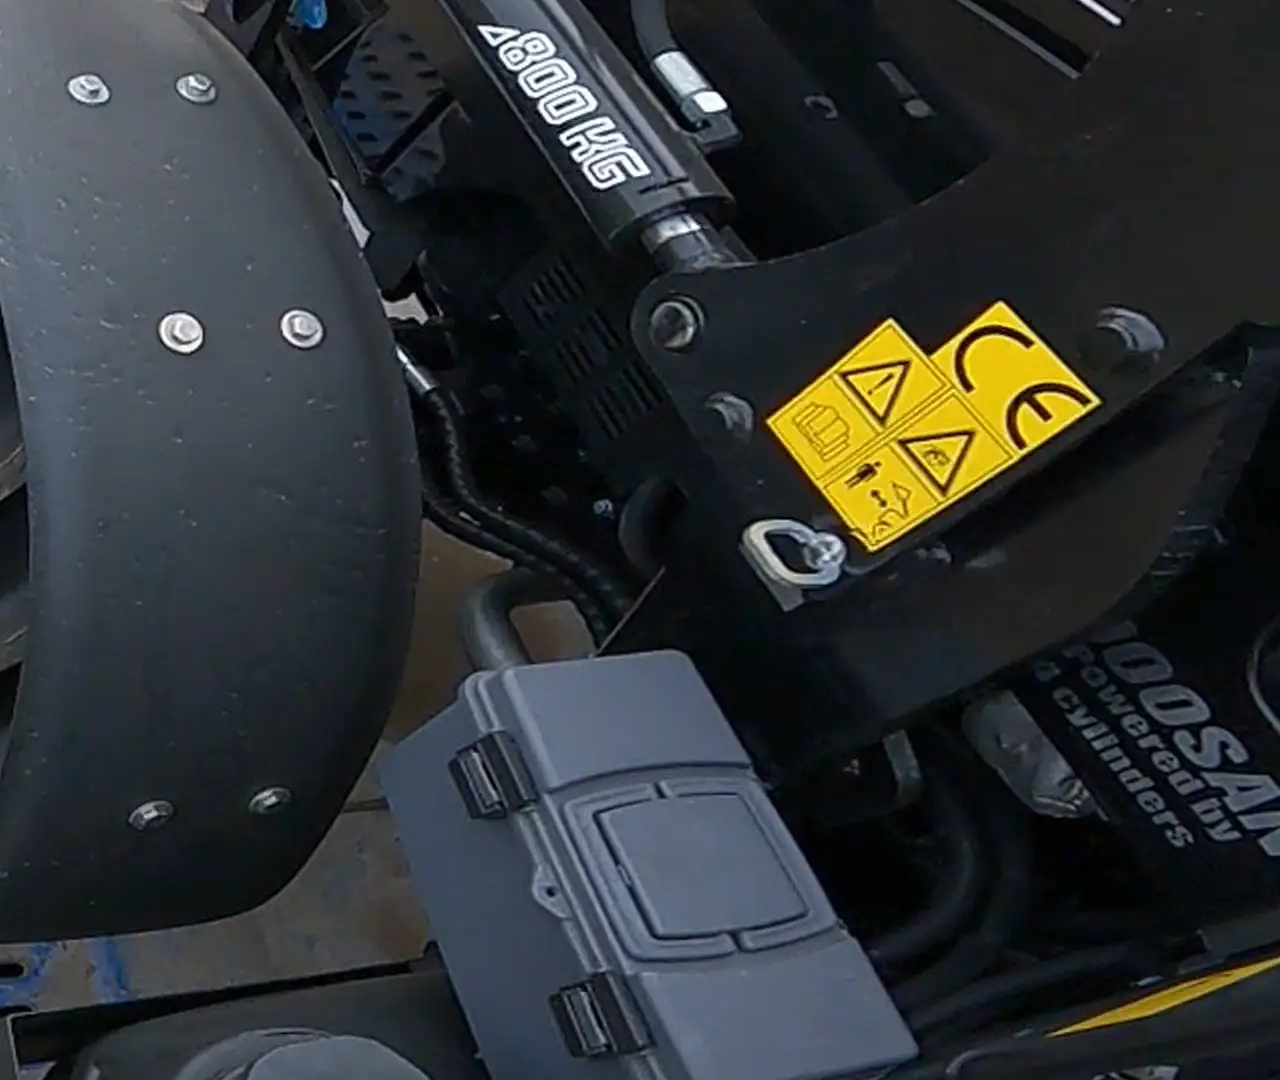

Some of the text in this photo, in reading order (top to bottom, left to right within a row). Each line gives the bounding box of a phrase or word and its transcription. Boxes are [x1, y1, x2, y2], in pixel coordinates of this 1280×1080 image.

[498, 31, 652, 191] 800 KG
[953, 323, 1092, 450] CE
[1051, 686, 1195, 849] cylinders
[1188, 796, 1243, 842] by
